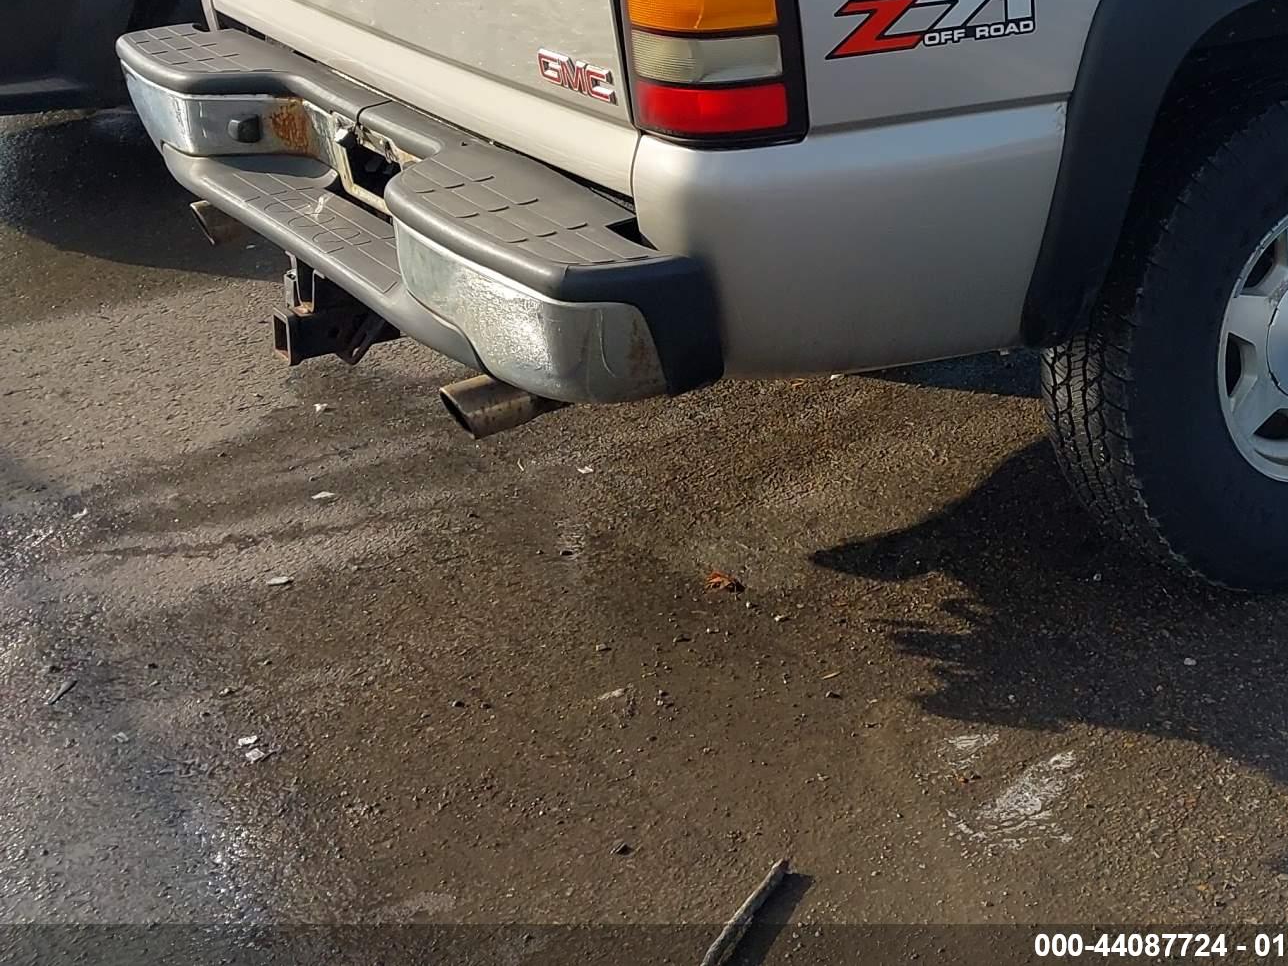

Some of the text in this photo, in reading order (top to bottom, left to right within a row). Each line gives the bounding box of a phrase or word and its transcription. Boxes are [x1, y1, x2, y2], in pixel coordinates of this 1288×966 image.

[923, 20, 1034, 46] OFF ROAD
[538, 48, 618, 106] GMC
